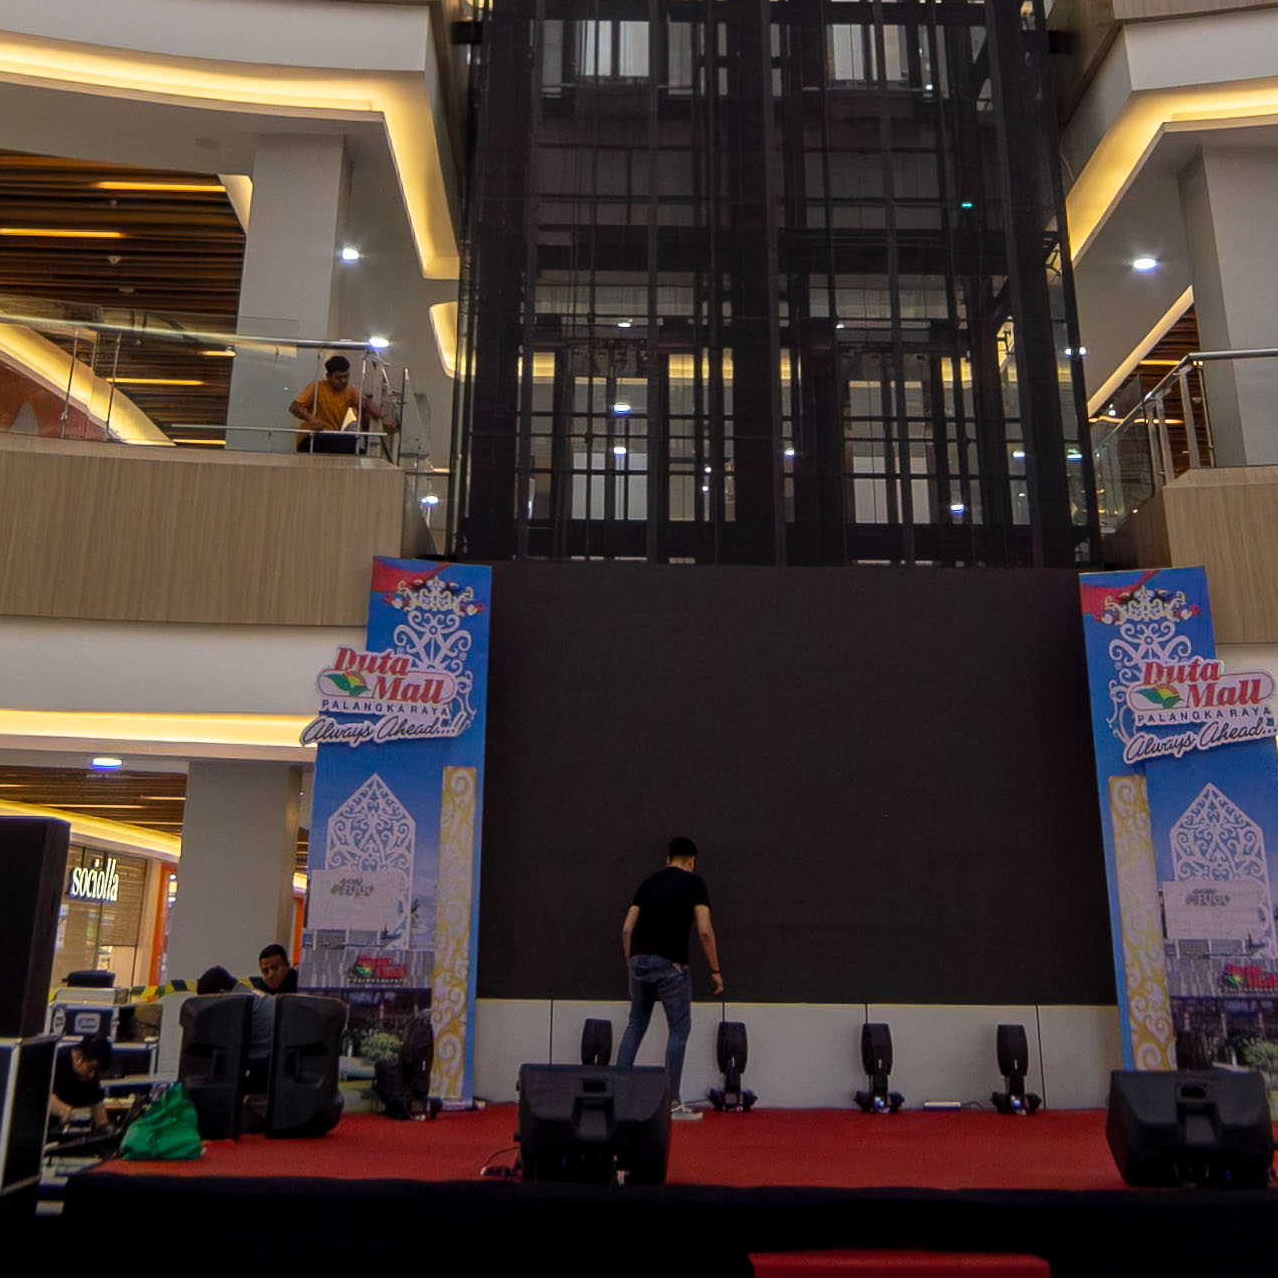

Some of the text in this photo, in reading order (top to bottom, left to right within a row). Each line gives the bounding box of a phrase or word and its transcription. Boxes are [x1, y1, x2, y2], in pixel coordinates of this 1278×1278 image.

[334, 648, 410, 676] Duta
[1143, 658, 1220, 686] Duta
[372, 676, 444, 704] Mall
[1186, 679, 1262, 708] Mall
[303, 718, 373, 742] Always
[1125, 734, 1195, 763] Always
[71, 857, 120, 902] sociolla
